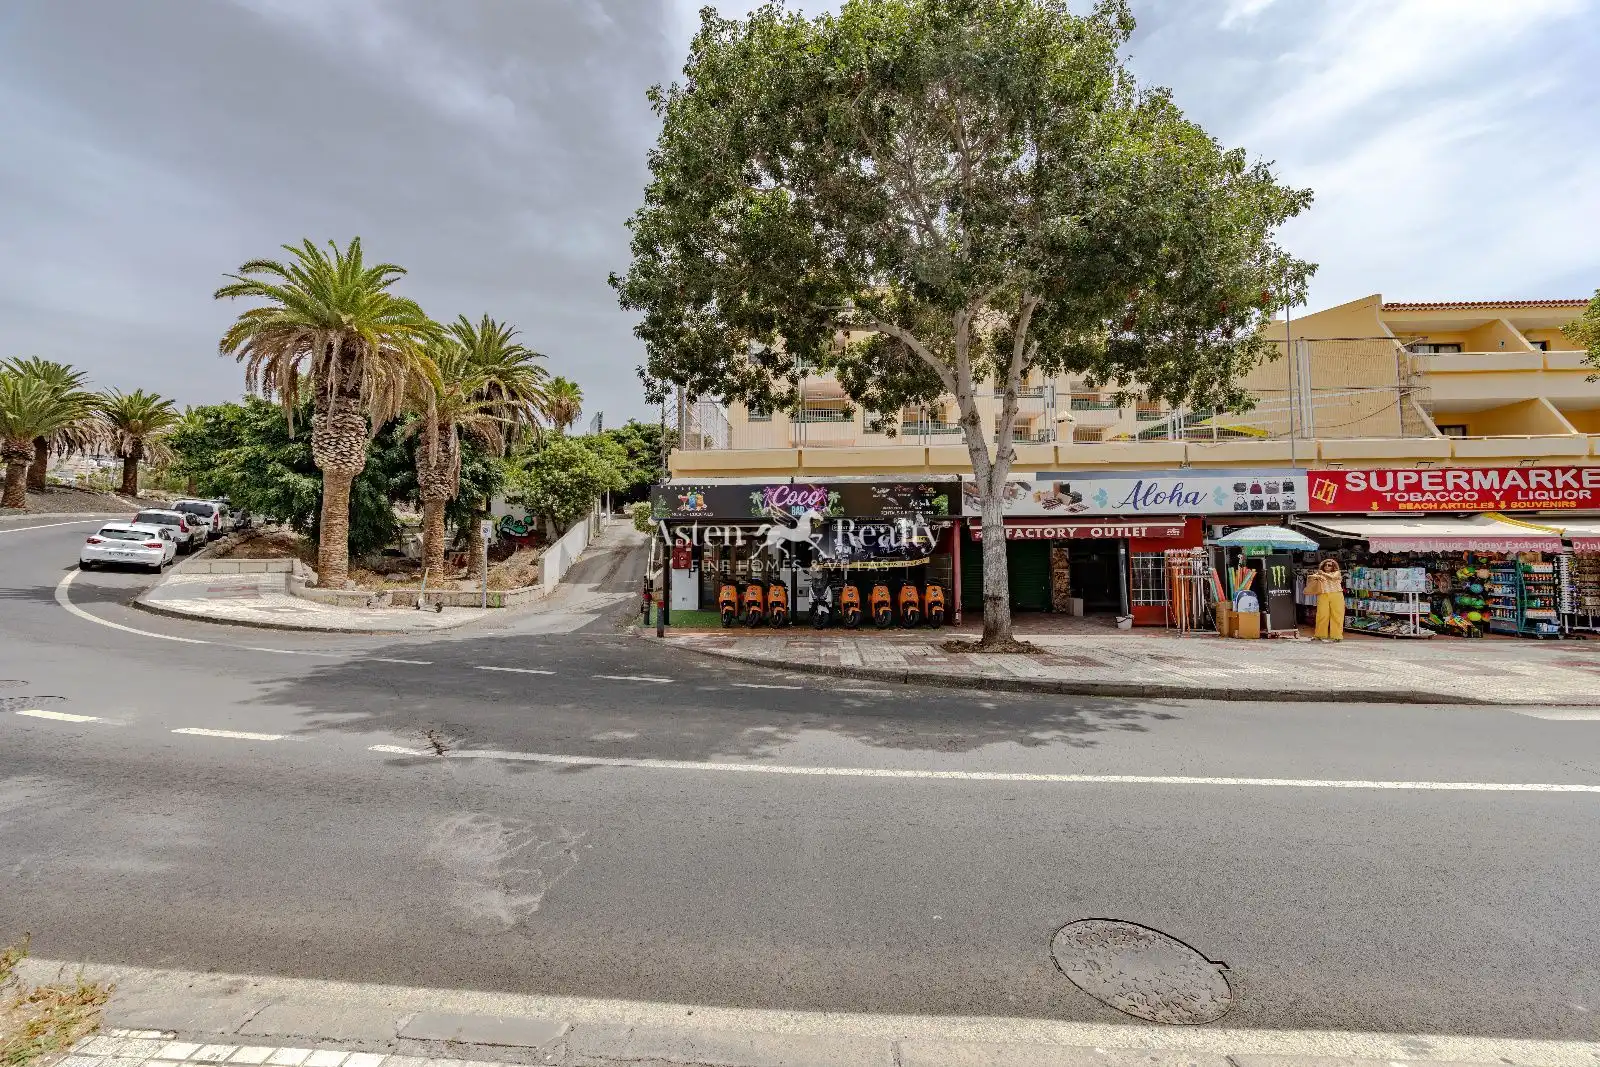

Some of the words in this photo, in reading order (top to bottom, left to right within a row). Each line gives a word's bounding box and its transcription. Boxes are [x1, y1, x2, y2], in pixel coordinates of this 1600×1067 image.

[1345, 470, 1600, 491] SUPERMARKE
[772, 485, 821, 507] Coco
[1112, 480, 1206, 511] Aloha
[1382, 491, 1479, 502] TOBACCO
[1492, 490, 1504, 500] Y
[1517, 490, 1592, 500] LIQUOR
[791, 505, 805, 516] BAR
[1399, 502, 1438, 510] BEACH
[1440, 501, 1495, 509] ARTICLES
[1006, 527, 1077, 538] FACTORY
[1090, 527, 1148, 537] OUTLET
[1505, 540, 1559, 550] Exchange
